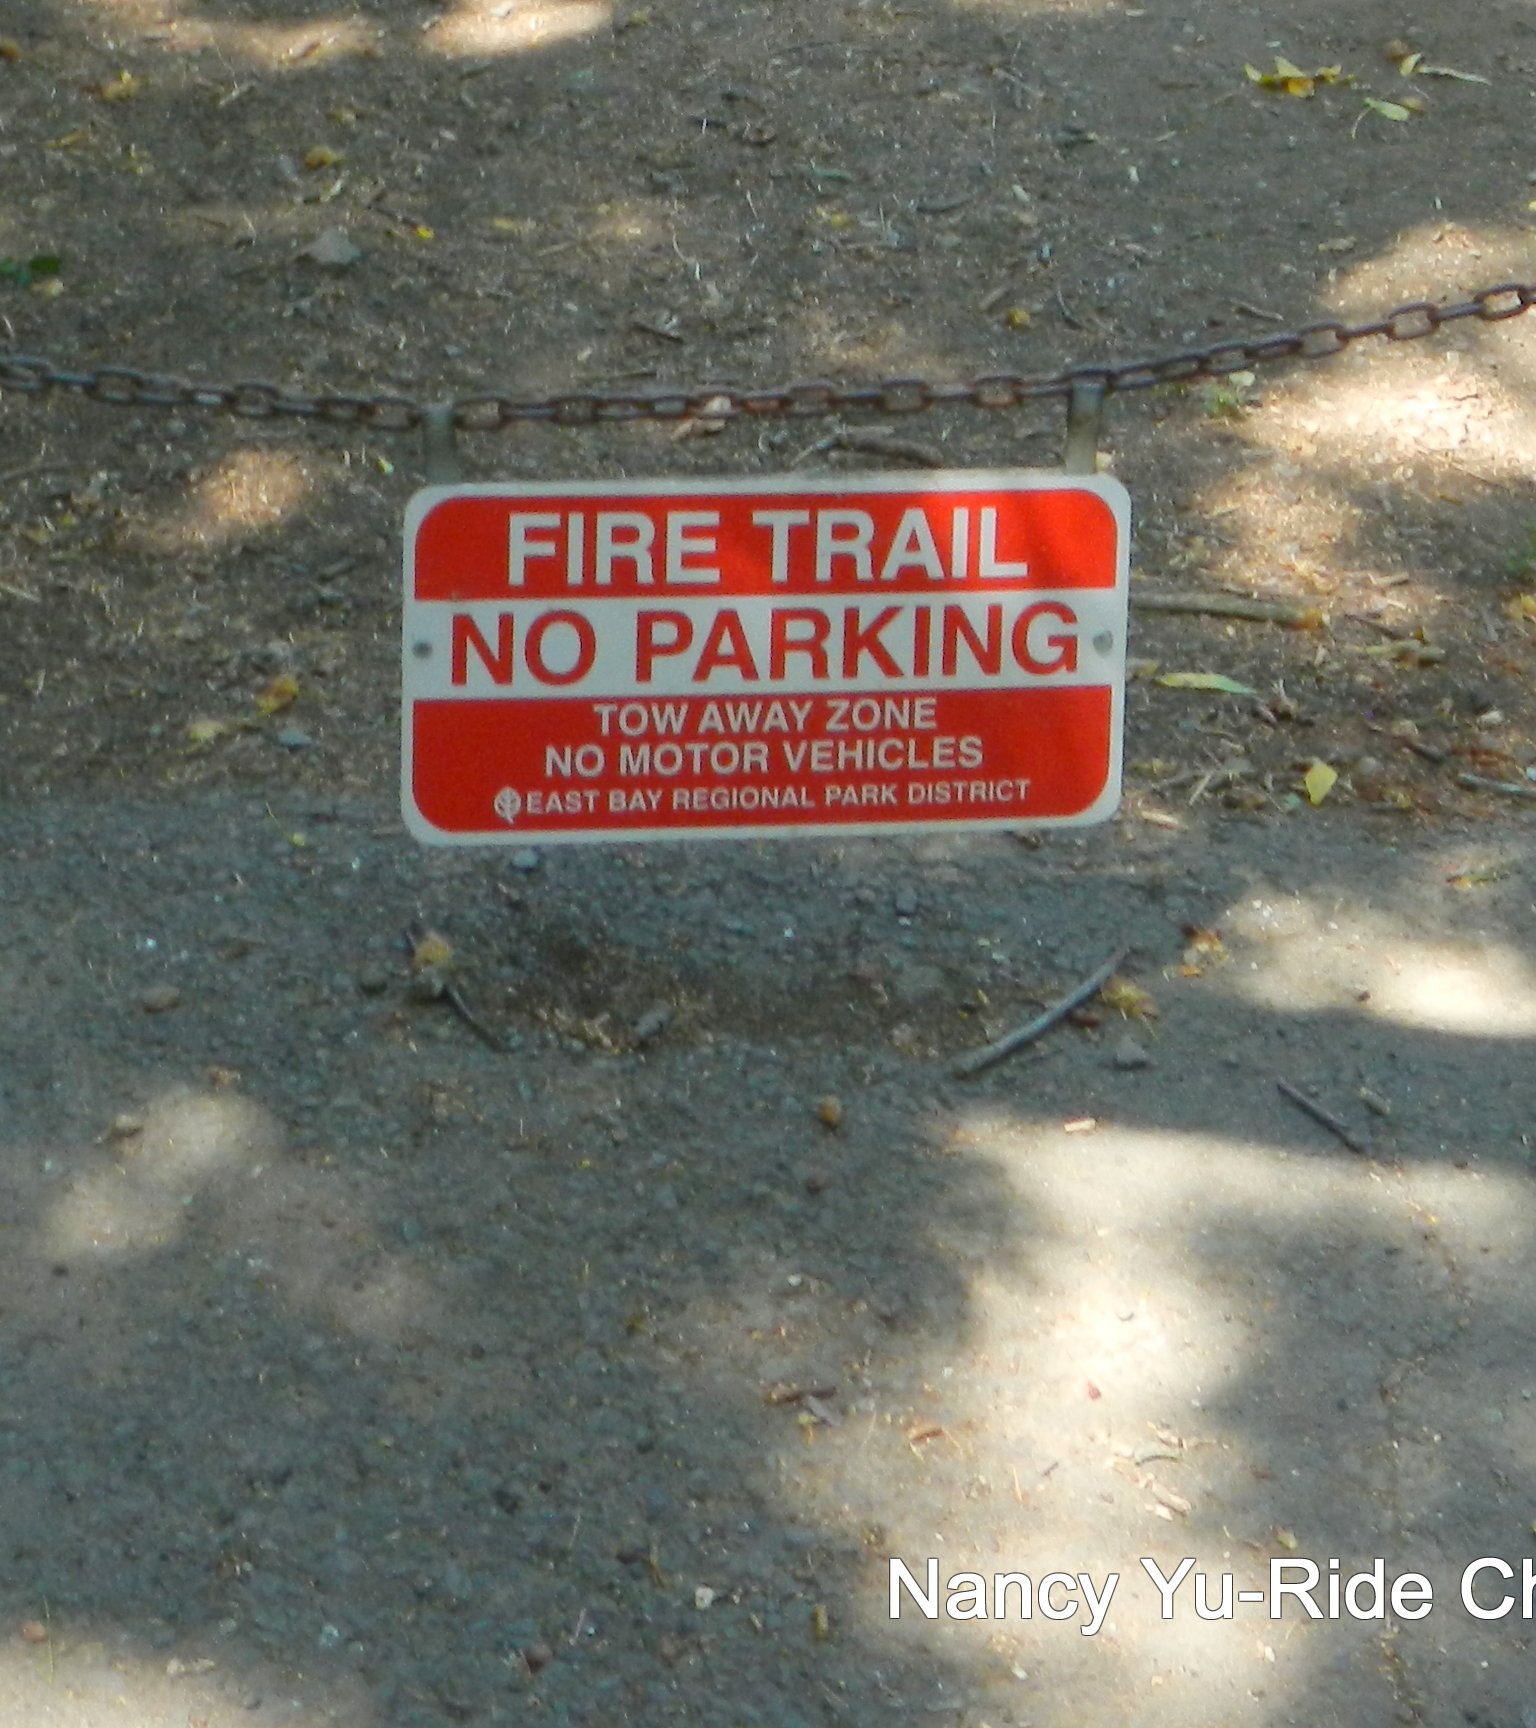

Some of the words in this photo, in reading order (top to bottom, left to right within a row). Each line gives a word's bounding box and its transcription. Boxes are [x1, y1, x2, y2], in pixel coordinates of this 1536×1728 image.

[506, 509, 721, 586] FIRE
[752, 506, 1028, 584] TRAIL
[450, 610, 596, 687] NO
[635, 601, 1078, 683] PARKING
[594, 702, 688, 735] TOW
[697, 699, 809, 733] AWAY
[826, 698, 936, 731] ZONE
[544, 746, 604, 778] NO
[620, 742, 769, 776] MOTOR
[784, 736, 983, 771] VEHICLES
[526, 790, 600, 814] EAST
[608, 788, 664, 812] BAY
[673, 784, 815, 811] REGIONAL
[825, 781, 897, 808] PARK
[906, 778, 1030, 804] DISTRICT
